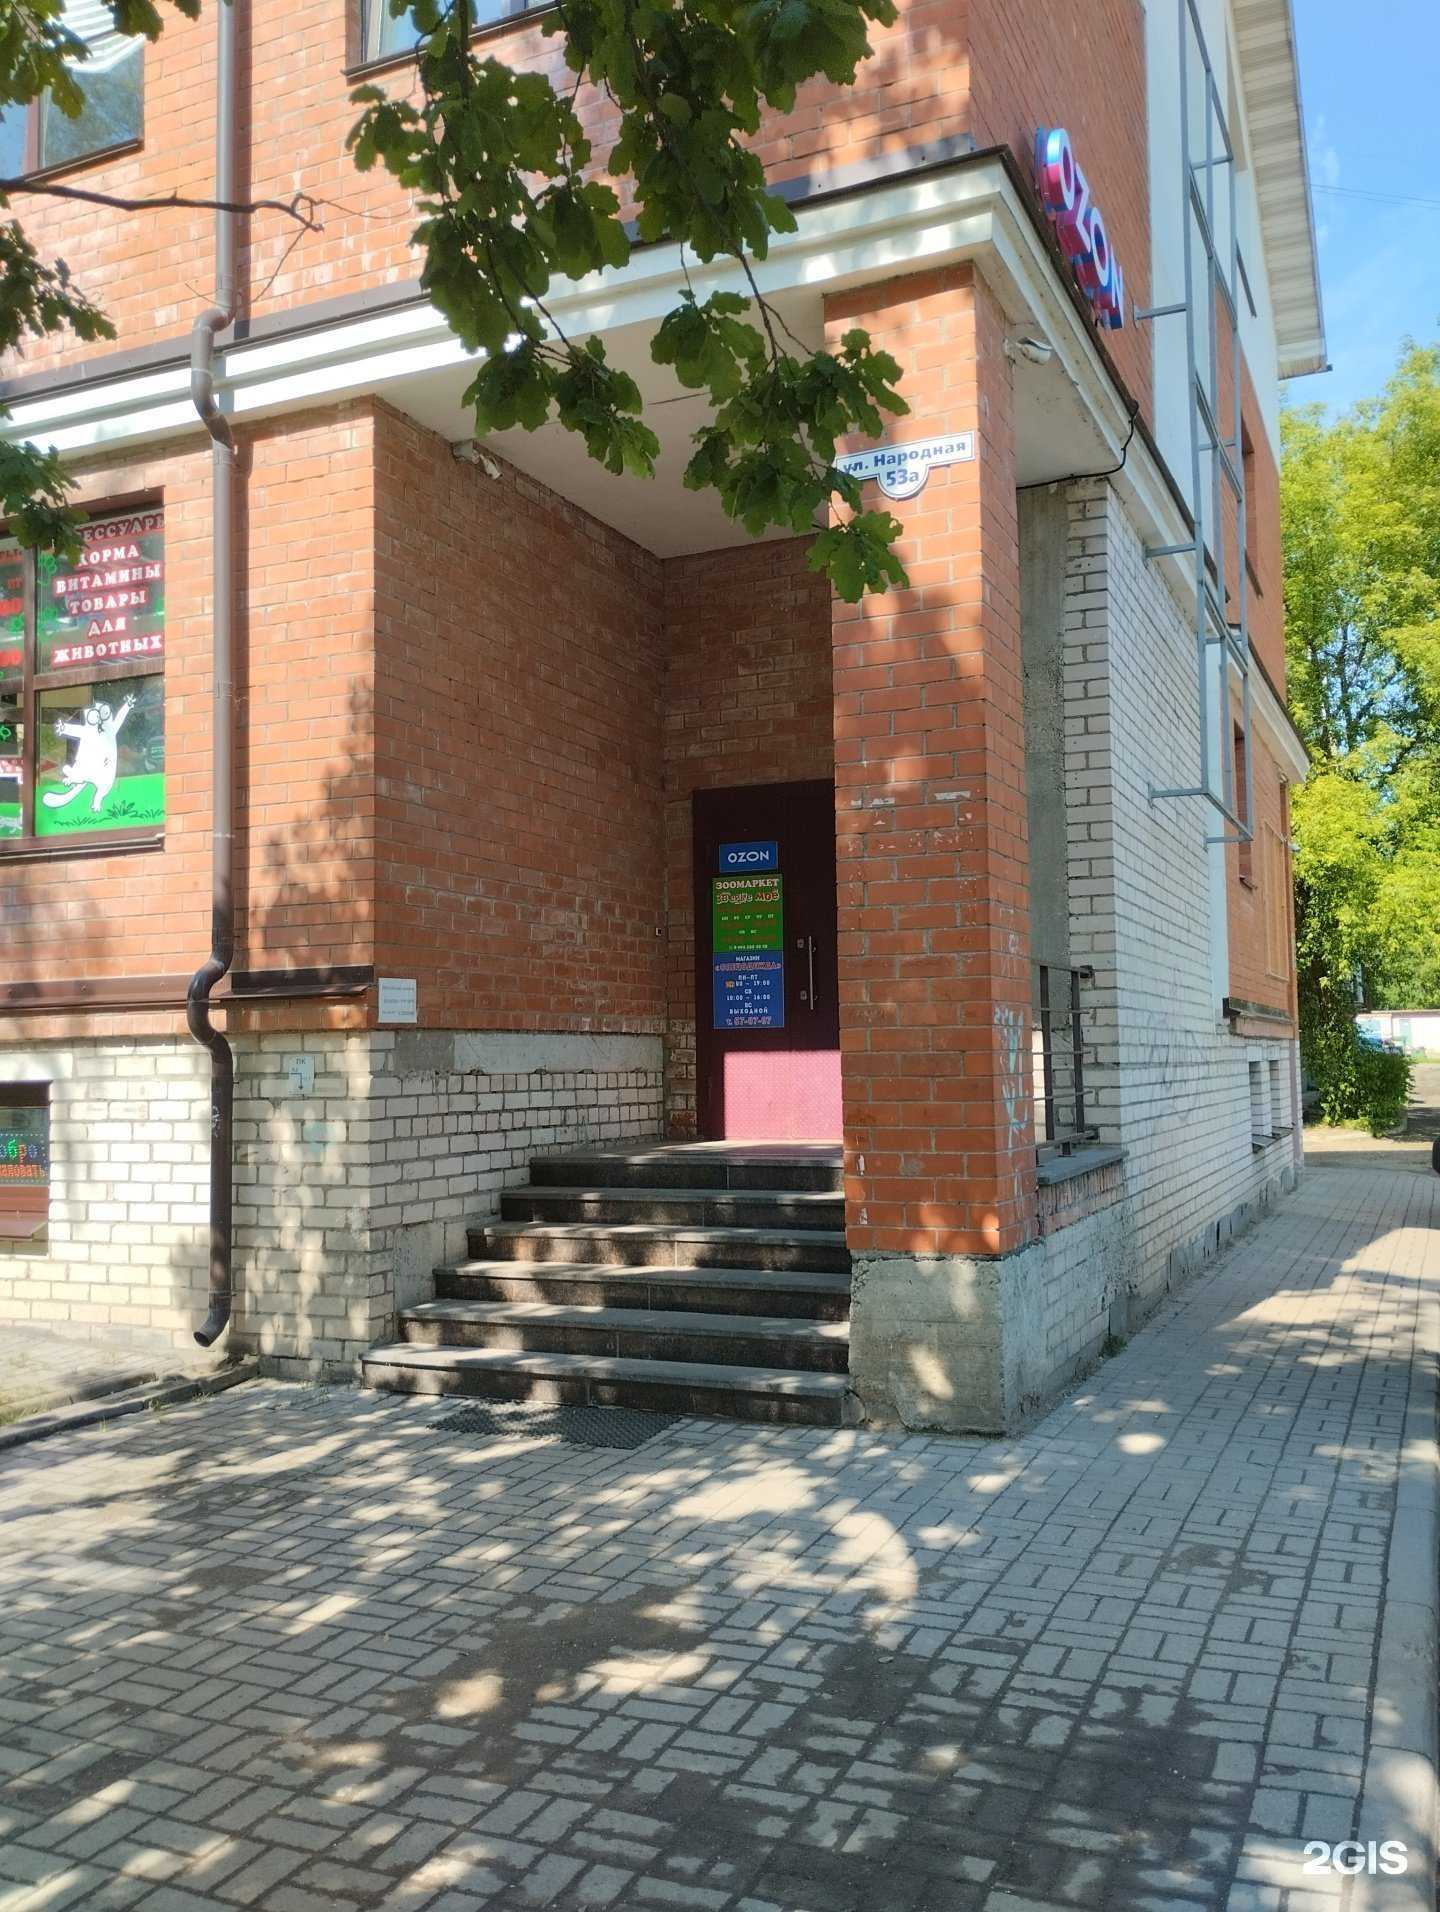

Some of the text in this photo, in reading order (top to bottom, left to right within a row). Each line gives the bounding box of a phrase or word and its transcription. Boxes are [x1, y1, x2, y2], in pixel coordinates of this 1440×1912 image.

[1036, 128, 1124, 329] OZON
[842, 441, 966, 475] ул. Народная
[886, 468, 919, 487] 53а
[56, 564, 161, 593] ВИТАМИНЫ
[70, 590, 146, 614] ТОВАРЫ
[88, 617, 127, 637] ДЛЯ
[54, 635, 162, 663] ЖИВОТНЫХ
[728, 850, 769, 863] OZON
[715, 878, 779, 890] ЗООМАРКЕТ
[729, 1006, 768, 1015] ВЫХОДНОЙ
